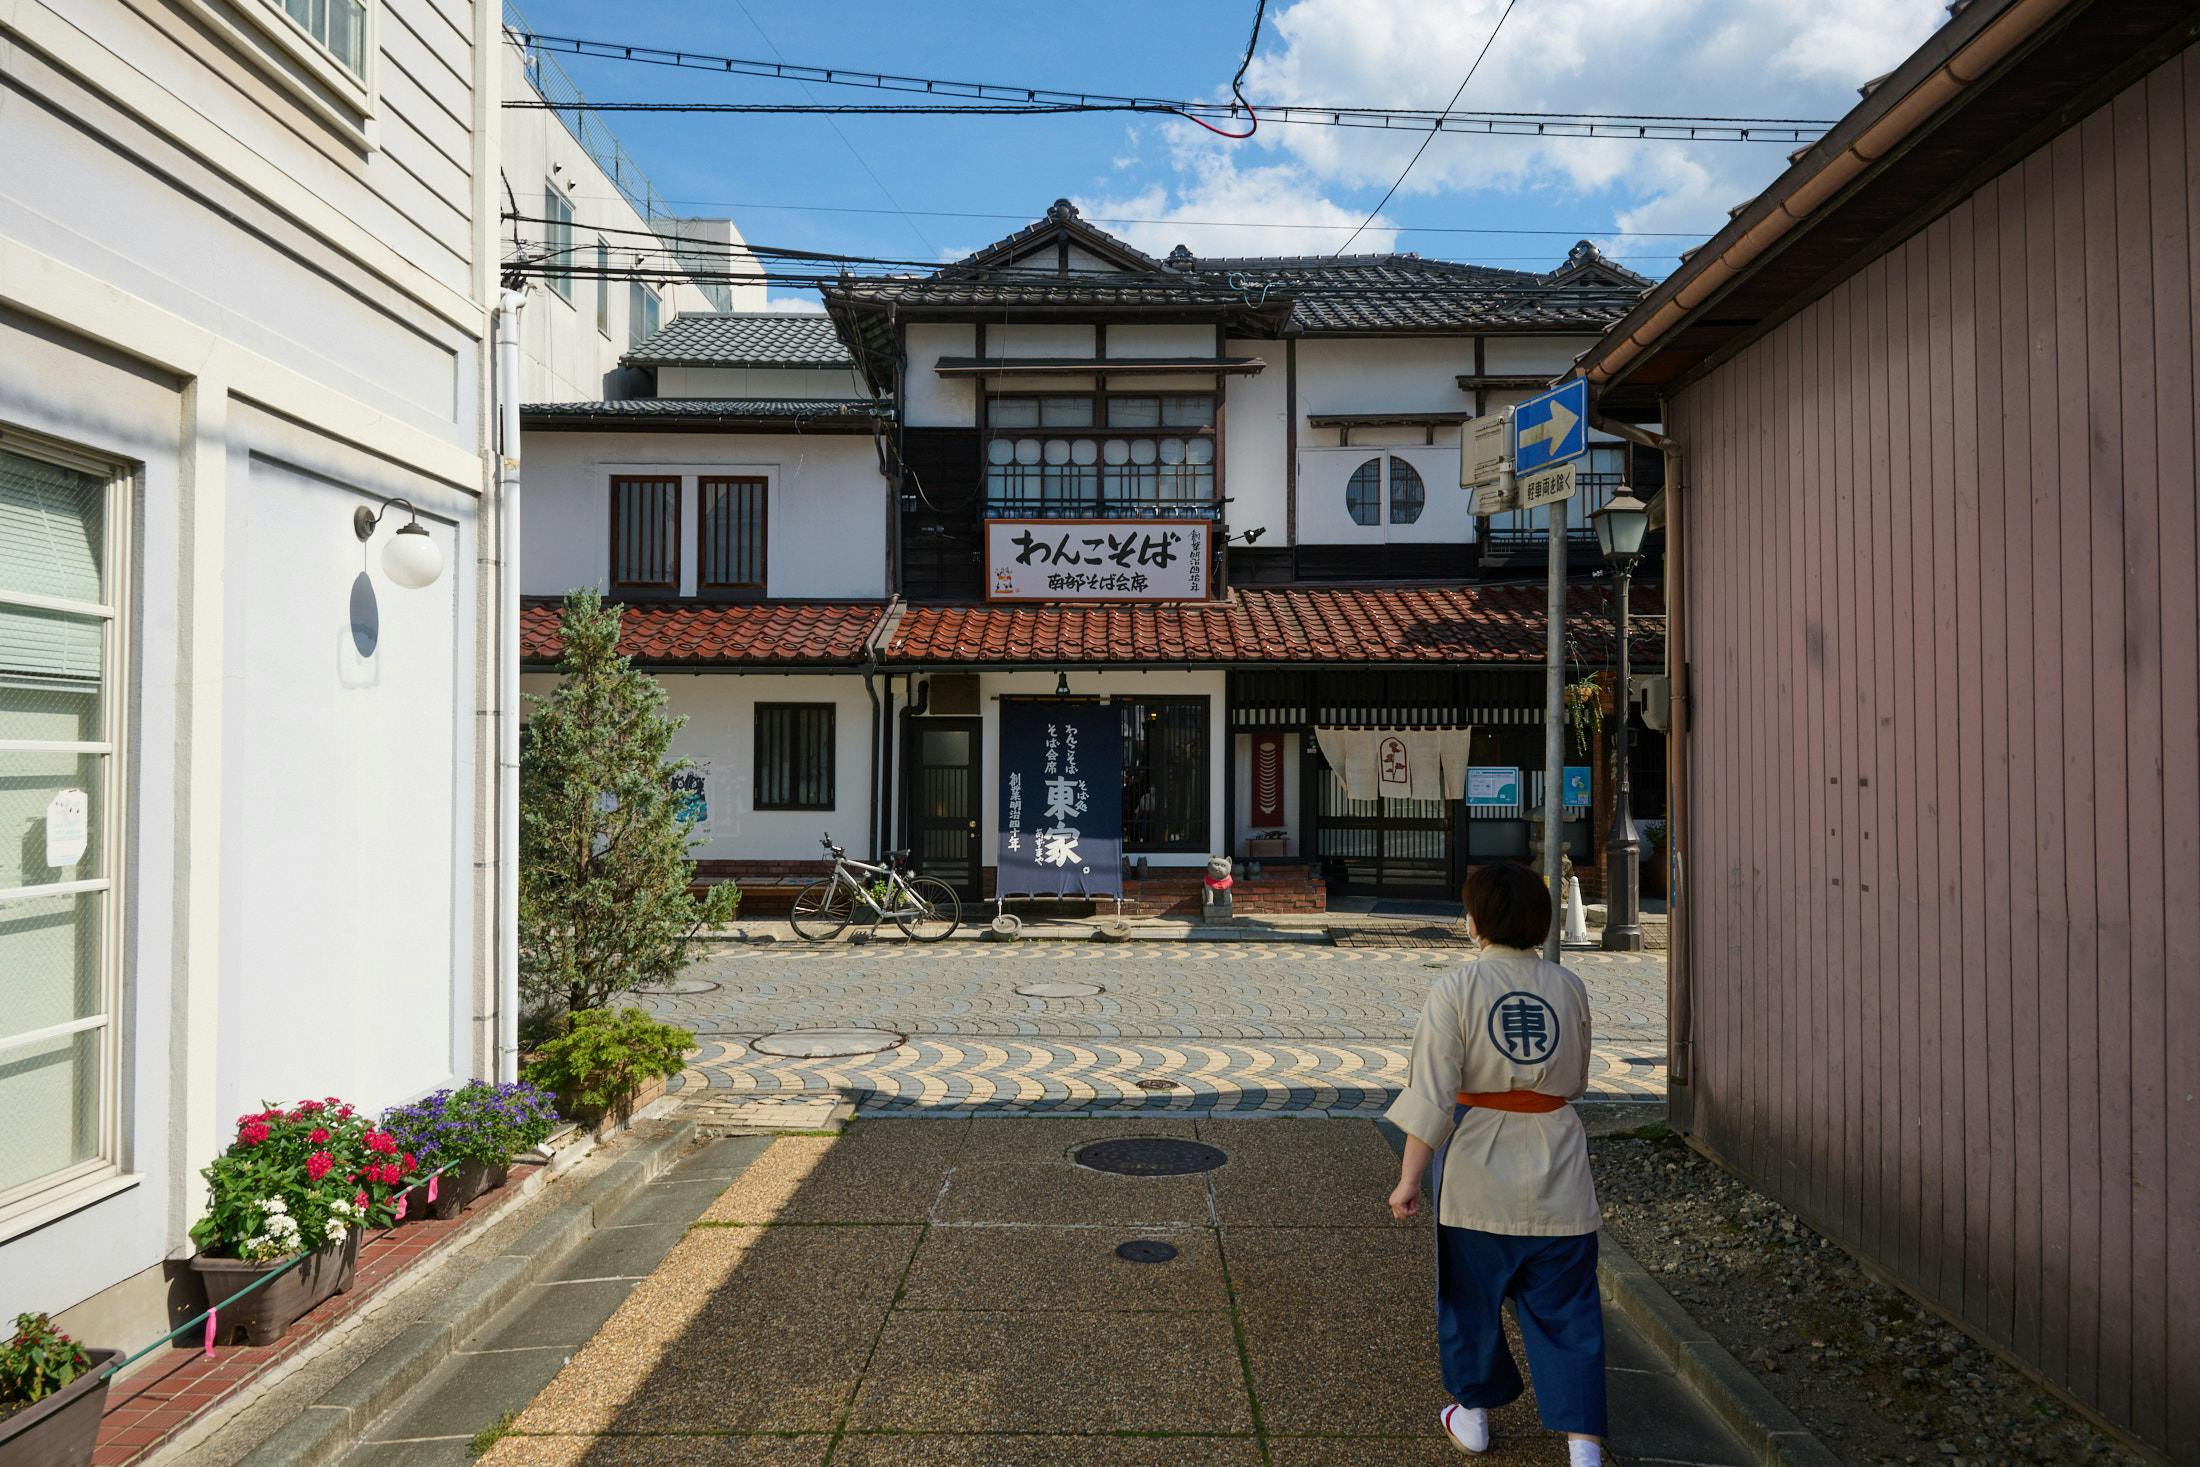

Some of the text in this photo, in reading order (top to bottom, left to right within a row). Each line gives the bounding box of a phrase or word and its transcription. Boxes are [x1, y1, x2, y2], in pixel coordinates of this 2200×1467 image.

[1528, 472, 1570, 500] 軽車両を除く
[1011, 529, 1181, 568] わんこそば
[1048, 573, 1149, 593] 南部そば会席
[1045, 723, 1060, 774] そば会席
[1065, 724, 1078, 775] わんこそば
[1008, 772, 1021, 852] 創業明治四十年
[1075, 779, 1090, 812] そば処
[1034, 828, 1044, 867] あずまや
